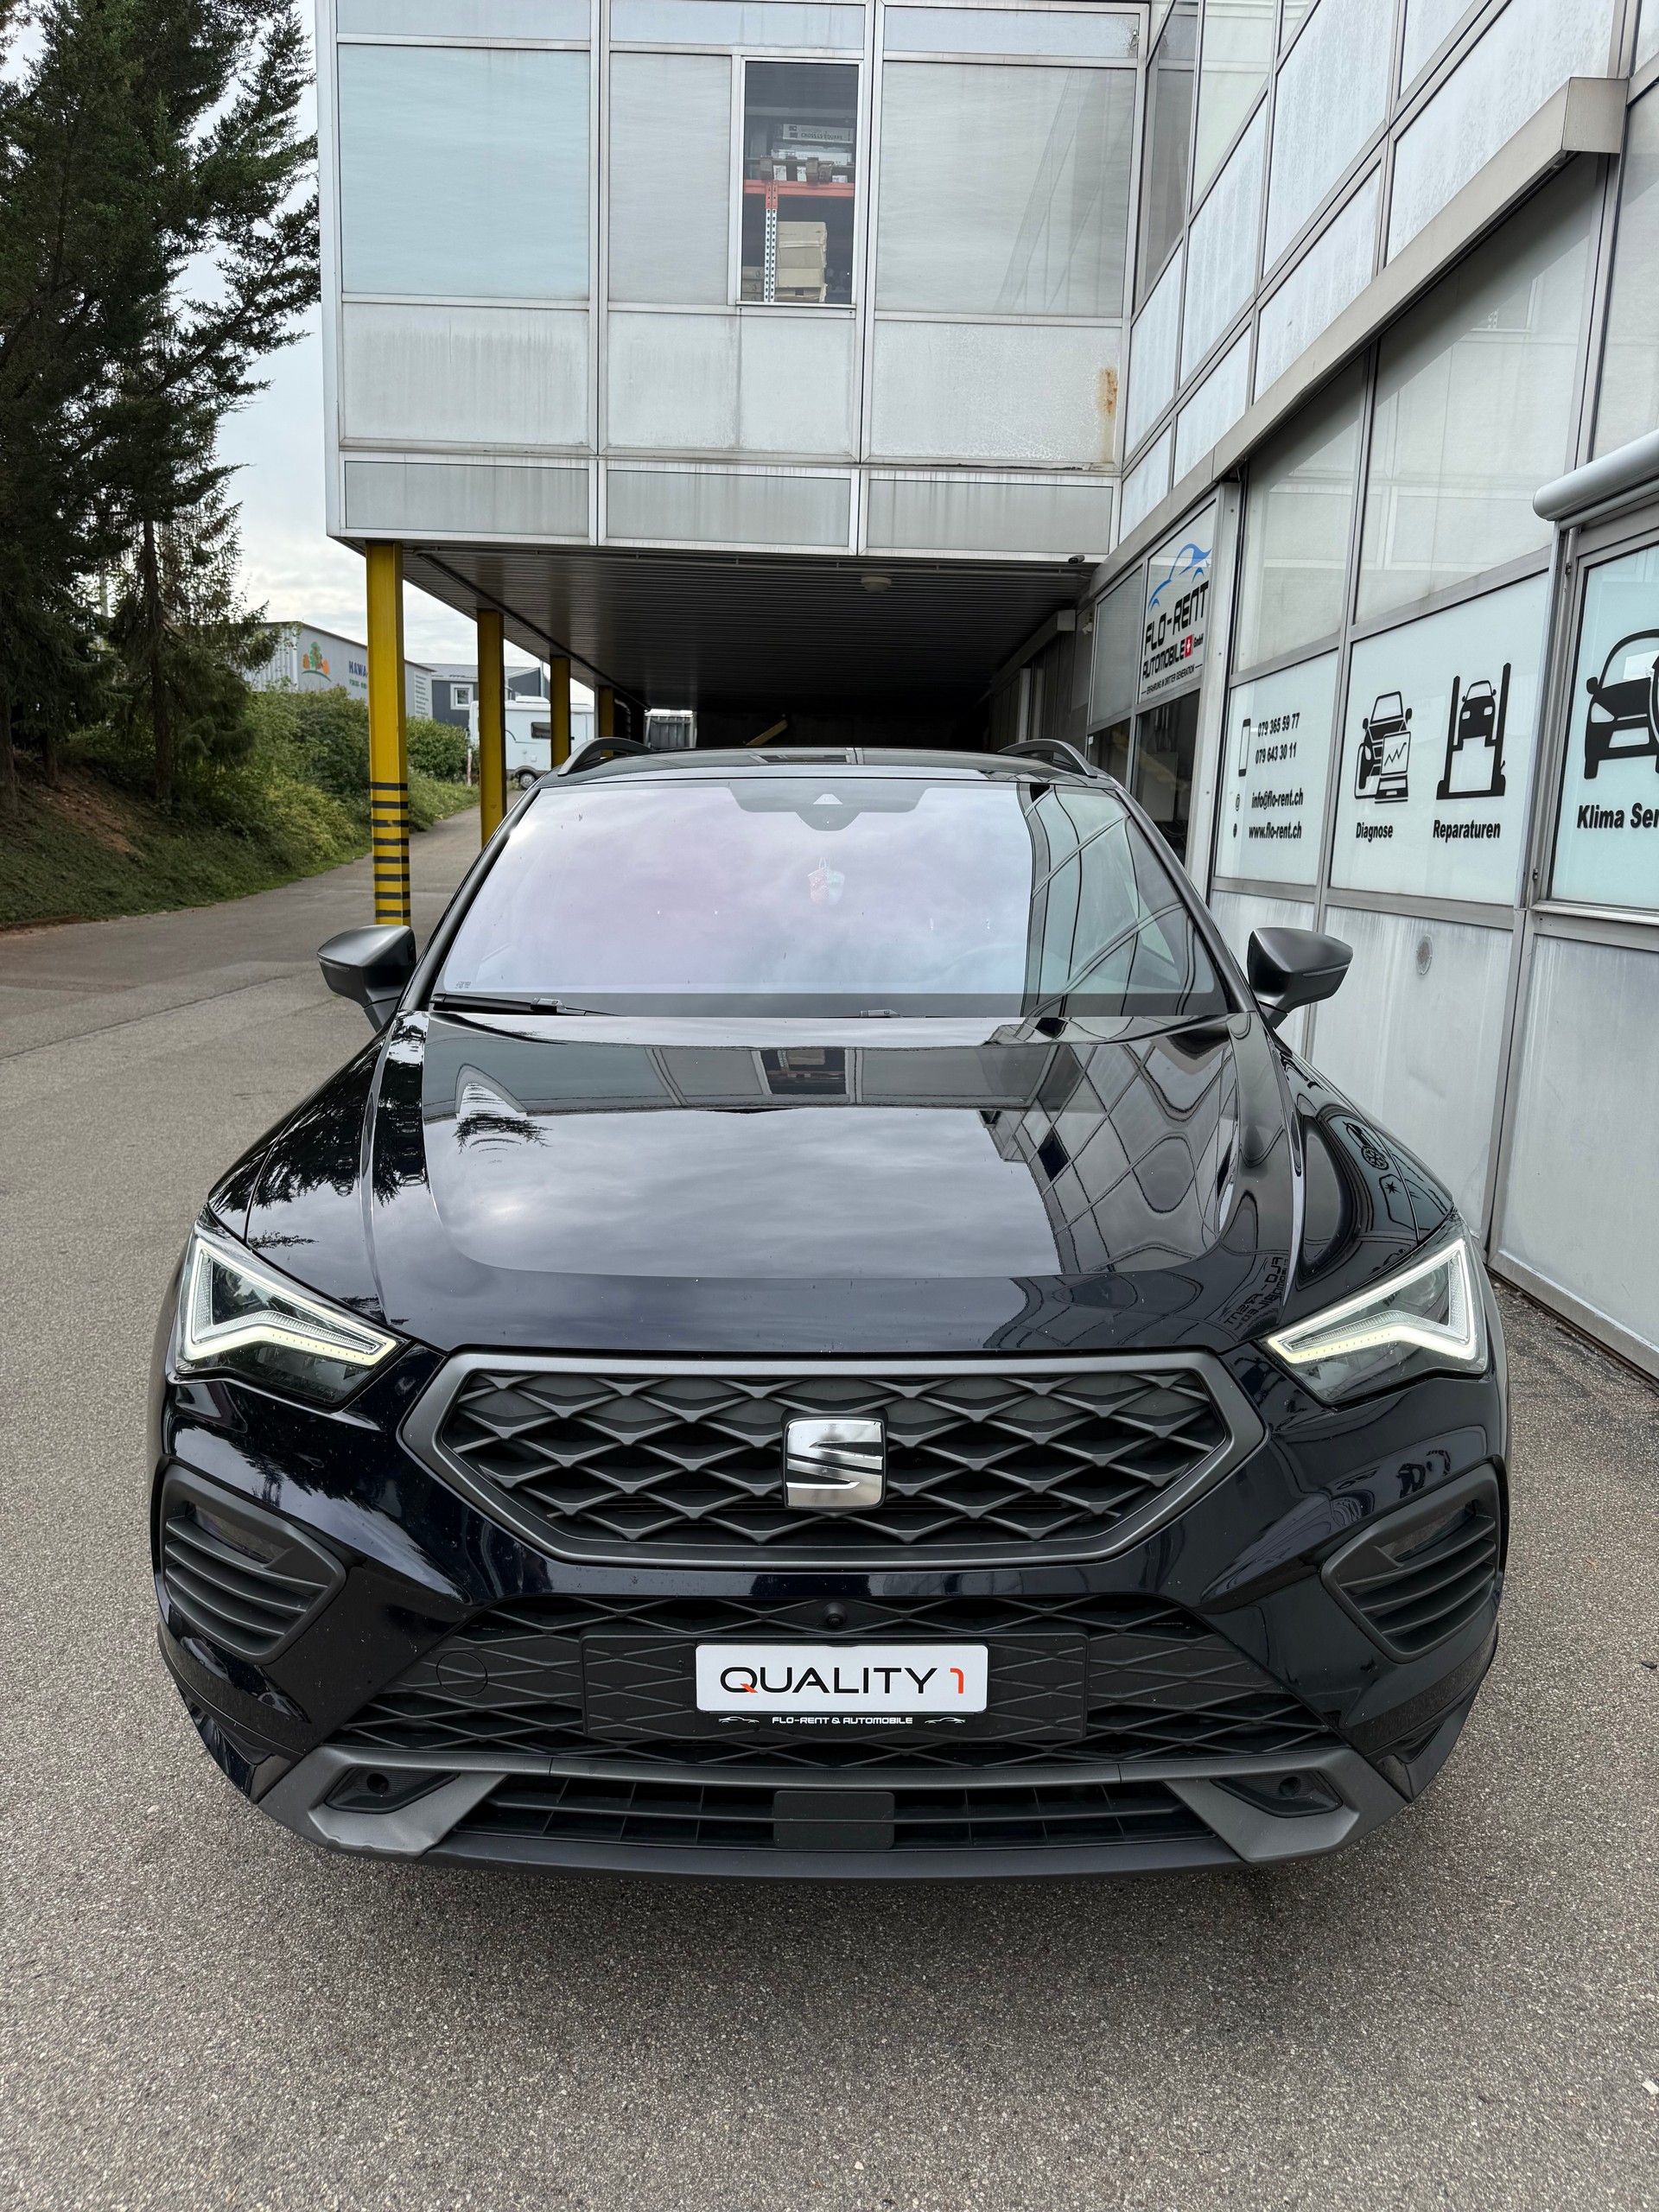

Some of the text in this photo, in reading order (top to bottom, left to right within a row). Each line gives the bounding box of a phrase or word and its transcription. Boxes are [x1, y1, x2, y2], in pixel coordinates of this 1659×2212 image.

[1144, 580, 1210, 656] FLO-RENT
[1141, 639, 1186, 681] AUTOMOBILE
[1257, 721, 1269, 737] 079
[1281, 715, 1291, 732] 59
[1291, 712, 1300, 728] 77
[1255, 747, 1267, 765] 079
[1279, 743, 1287, 760] 30
[1288, 741, 1297, 758] 11
[1251, 787, 1304, 810] info@flo-rent.ch
[1577, 804, 1625, 829] Klima
[1249, 821, 1302, 839] www.flo-rent.ch
[1356, 822, 1394, 843] Diagnose
[1433, 819, 1501, 843] Reparaturen
[720, 1666, 965, 1694] QUALITY 1
[772, 1717, 830, 1726] FLO-RENT
[842, 1717, 913, 1726] AUTOMOBILE
